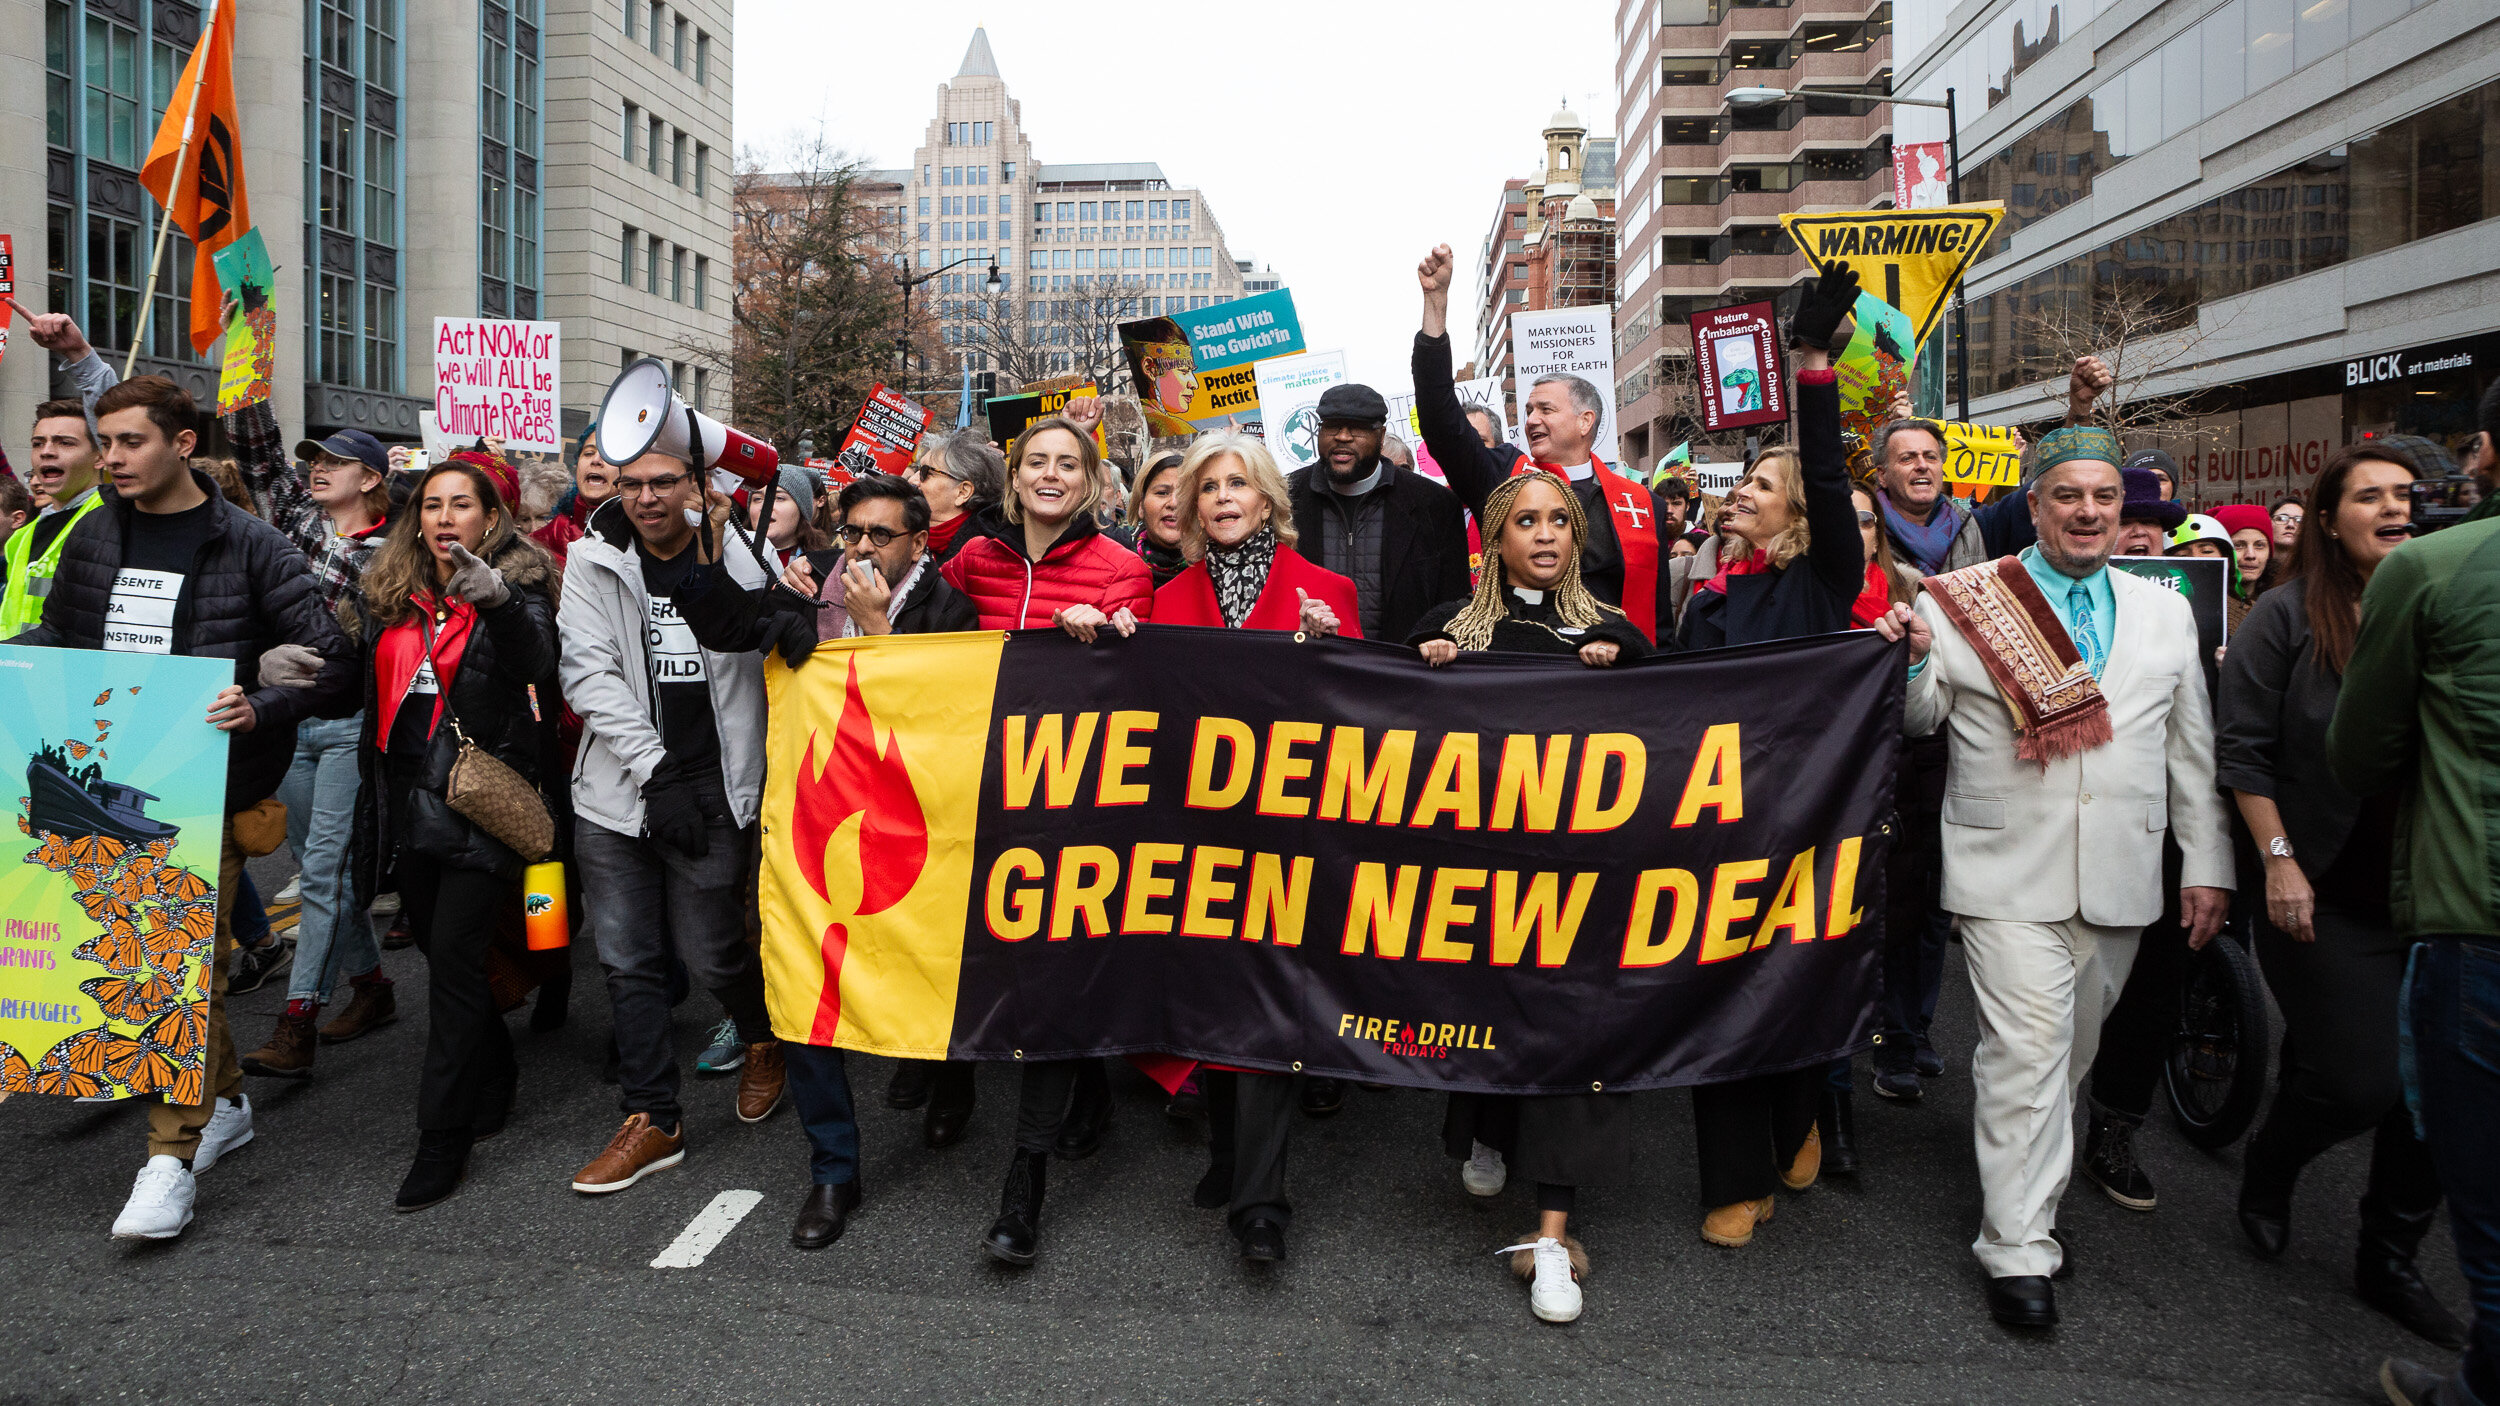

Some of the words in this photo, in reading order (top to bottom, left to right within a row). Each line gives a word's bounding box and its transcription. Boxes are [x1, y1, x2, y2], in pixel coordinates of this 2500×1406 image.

[1818, 223, 1974, 257] WARMING!
[1193, 318, 1236, 341] Stand
[1235, 309, 1274, 331] With
[1714, 312, 1749, 325] Nature
[437, 323, 474, 356] Act
[479, 324, 532, 361] NOW,
[533, 333, 553, 360] or
[1528, 324, 1596, 338] MARYKNOLL
[1530, 336, 1596, 349] MISSIONERS
[1707, 323, 1760, 339] Imbalance
[1199, 343, 1226, 361] The
[1552, 350, 1574, 361] FOR
[1761, 329, 1774, 369] Climate
[437, 361, 461, 384] we
[465, 358, 492, 387] will
[498, 359, 529, 390] ALL
[533, 362, 552, 392] be
[1262, 373, 1296, 385] climate
[1298, 367, 1329, 381] justice
[1521, 362, 1567, 375] MOTHER
[1571, 360, 1608, 372] EARTH
[1700, 339, 1714, 397] Extinctions
[2346, 353, 2402, 387] BLICK
[2408, 362, 2422, 375] art
[2424, 352, 2473, 373] materials
[1285, 374, 1330, 390] matters
[1767, 371, 1780, 412] Change
[436, 385, 500, 437] Climate
[1041, 394, 1065, 413] NO
[1211, 390, 1253, 410] Arctic
[864, 409, 880, 422] THE
[880, 418, 914, 439] CLIMATE
[868, 400, 890, 413] STOP
[889, 410, 922, 431] MAKING
[1708, 399, 1718, 426] Mass
[860, 419, 885, 436] CRISIS
[885, 432, 915, 450] WORSE
[1241, 425, 1264, 434] LIMA
[1943, 450, 2020, 483] OFIT
[1698, 472, 1743, 489] Clima
[113, 577, 163, 590] ESENTE
[108, 603, 124, 614] RA
[105, 631, 163, 646] NSTRUIR
[1003, 710, 1160, 810] WE
[1184, 716, 1647, 834] DEMAND
[1670, 722, 1744, 829] A
[984, 842, 1315, 947] GREEN
[1340, 861, 1600, 969] NEW
[1618, 836, 1864, 969] DEAL
[5, 918, 61, 942] RIGHTS
[0, 946, 56, 970] RANTS
[0, 997, 82, 1025] REFUGEES
[1338, 1013, 1400, 1043] FIRE
[1418, 1022, 1496, 1050] DRILL
[1382, 1042, 1447, 1059] FRIDAYS
